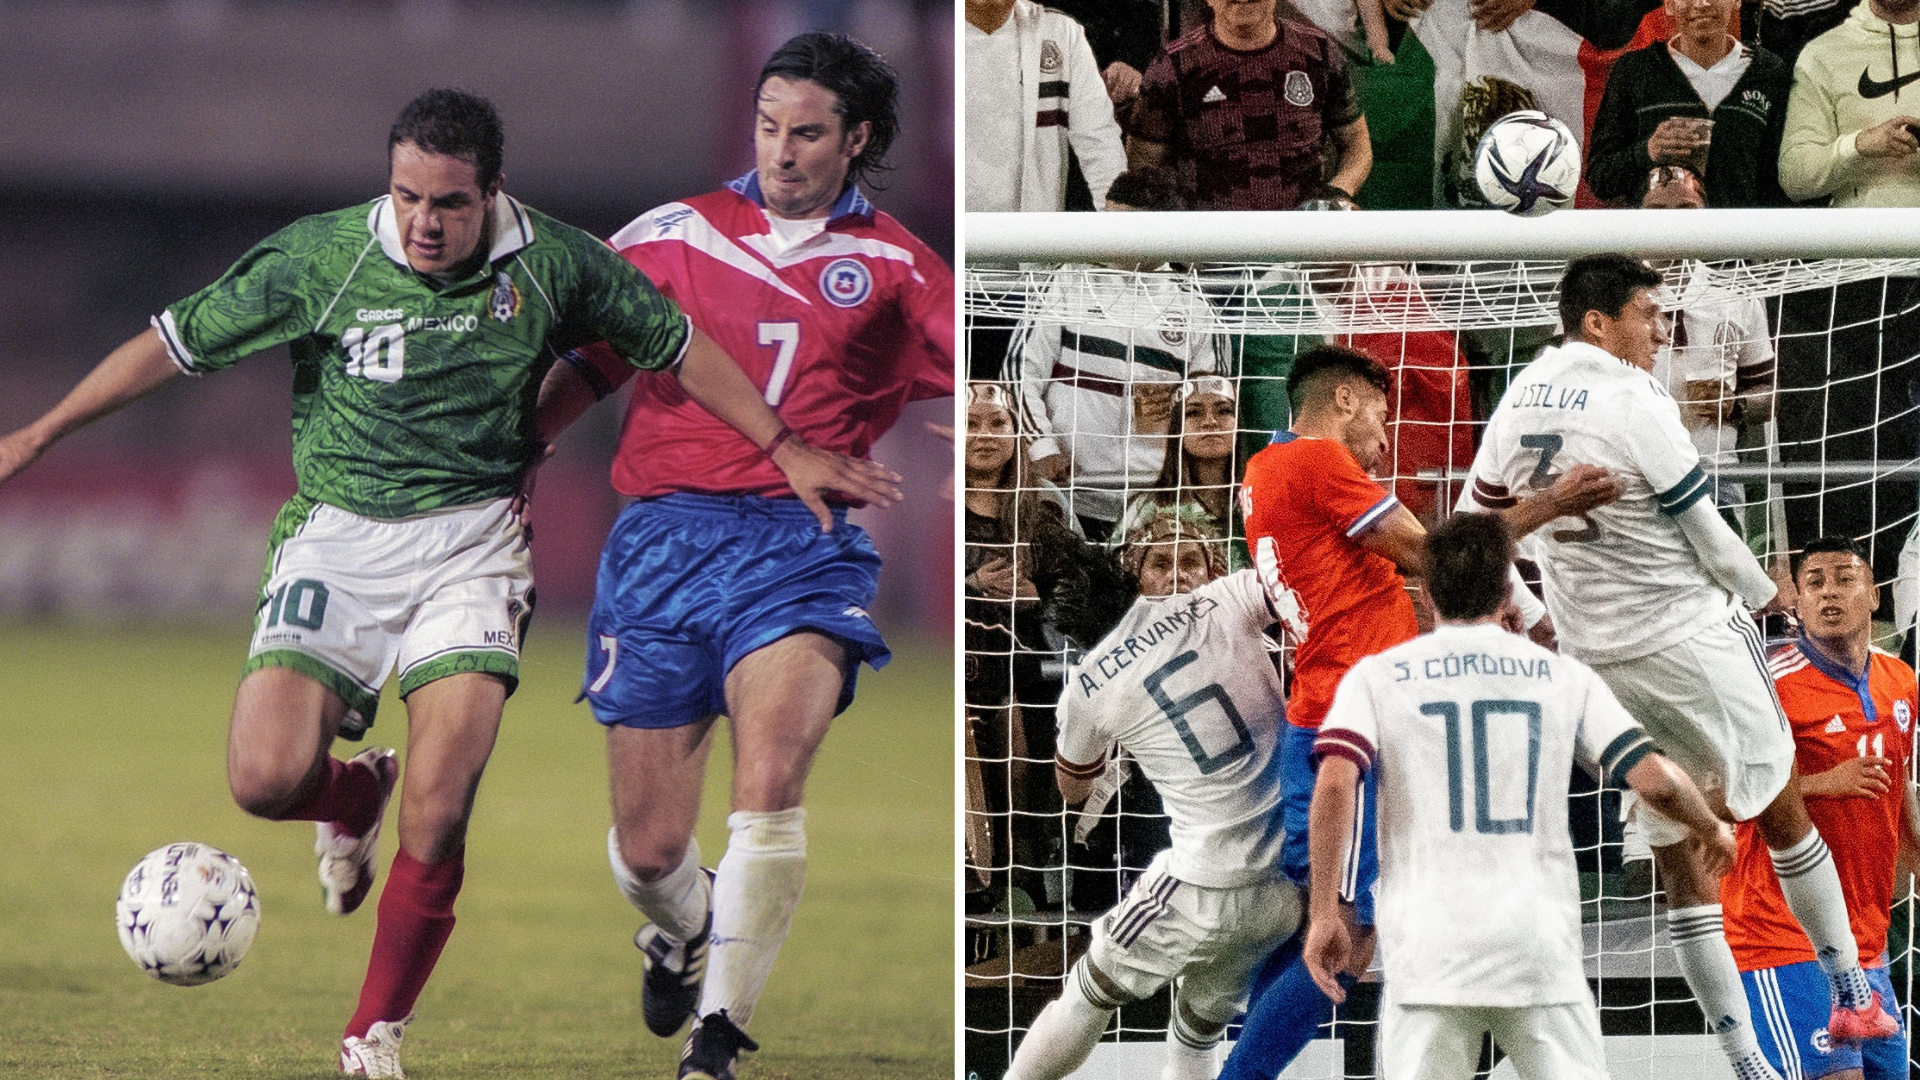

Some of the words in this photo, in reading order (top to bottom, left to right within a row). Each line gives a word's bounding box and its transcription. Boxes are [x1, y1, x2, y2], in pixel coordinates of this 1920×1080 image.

[355, 308, 404, 322] GARCIS
[407, 314, 479, 332] MEXICO
[341, 323, 405, 383] 10
[756, 318, 801, 406] 7
[265, 578, 330, 631] 10
[588, 634, 618, 692] 7
[1143, 649, 1255, 775] 6
[1419, 699, 1543, 836] 10
[1856, 733, 1884, 758] 11
